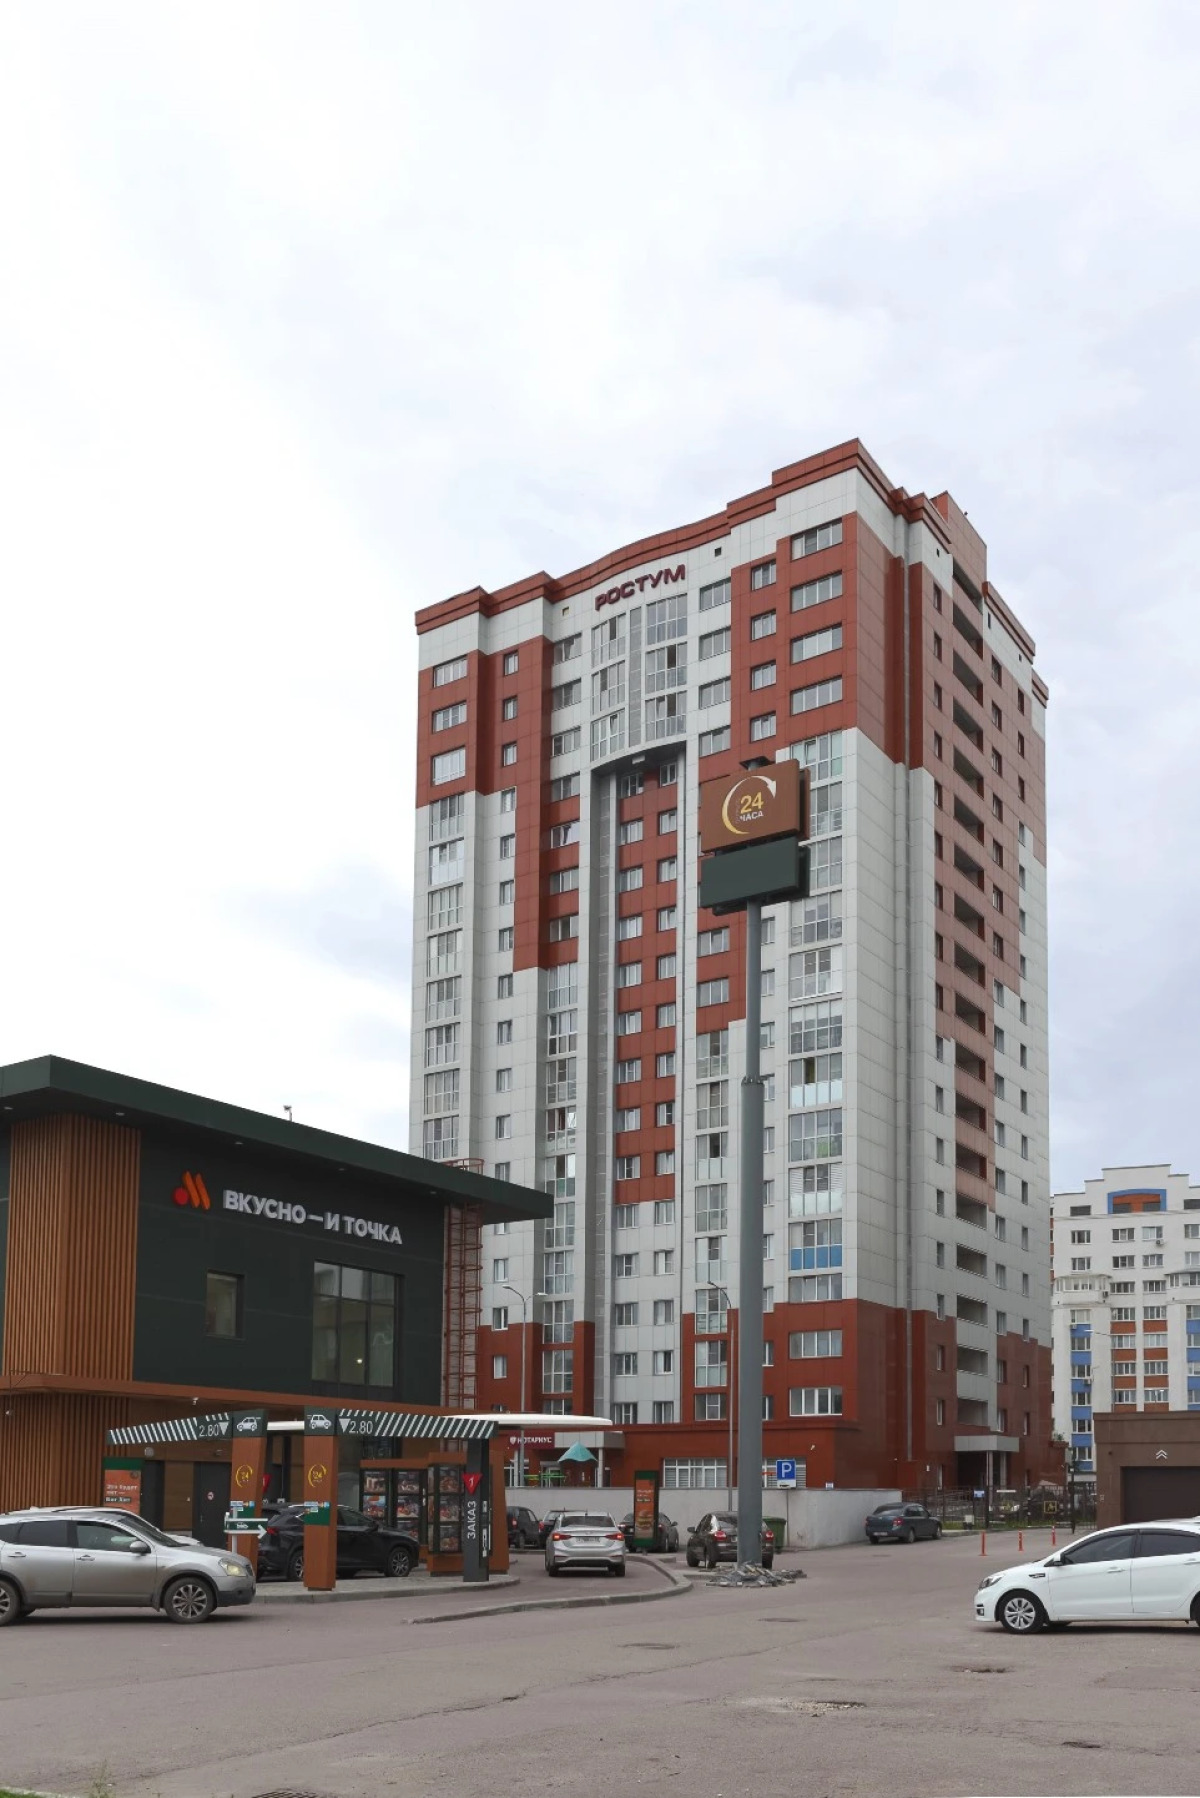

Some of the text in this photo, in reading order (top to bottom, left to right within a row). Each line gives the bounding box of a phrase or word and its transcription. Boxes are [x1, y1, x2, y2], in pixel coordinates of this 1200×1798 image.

[595, 564, 686, 611] РОСТУМ
[740, 791, 764, 815] 24
[740, 810, 764, 822] ЧАСА
[223, 1189, 306, 1224] ВКУСНО
[341, 1215, 402, 1245] ТОЧКА
[199, 1425, 219, 1437] 2.80
[349, 1420, 373, 1434] 2.80
[781, 1462, 792, 1477] P
[468, 1476, 475, 1487] 1
[467, 1500, 477, 1540] ЗАКАЗ
